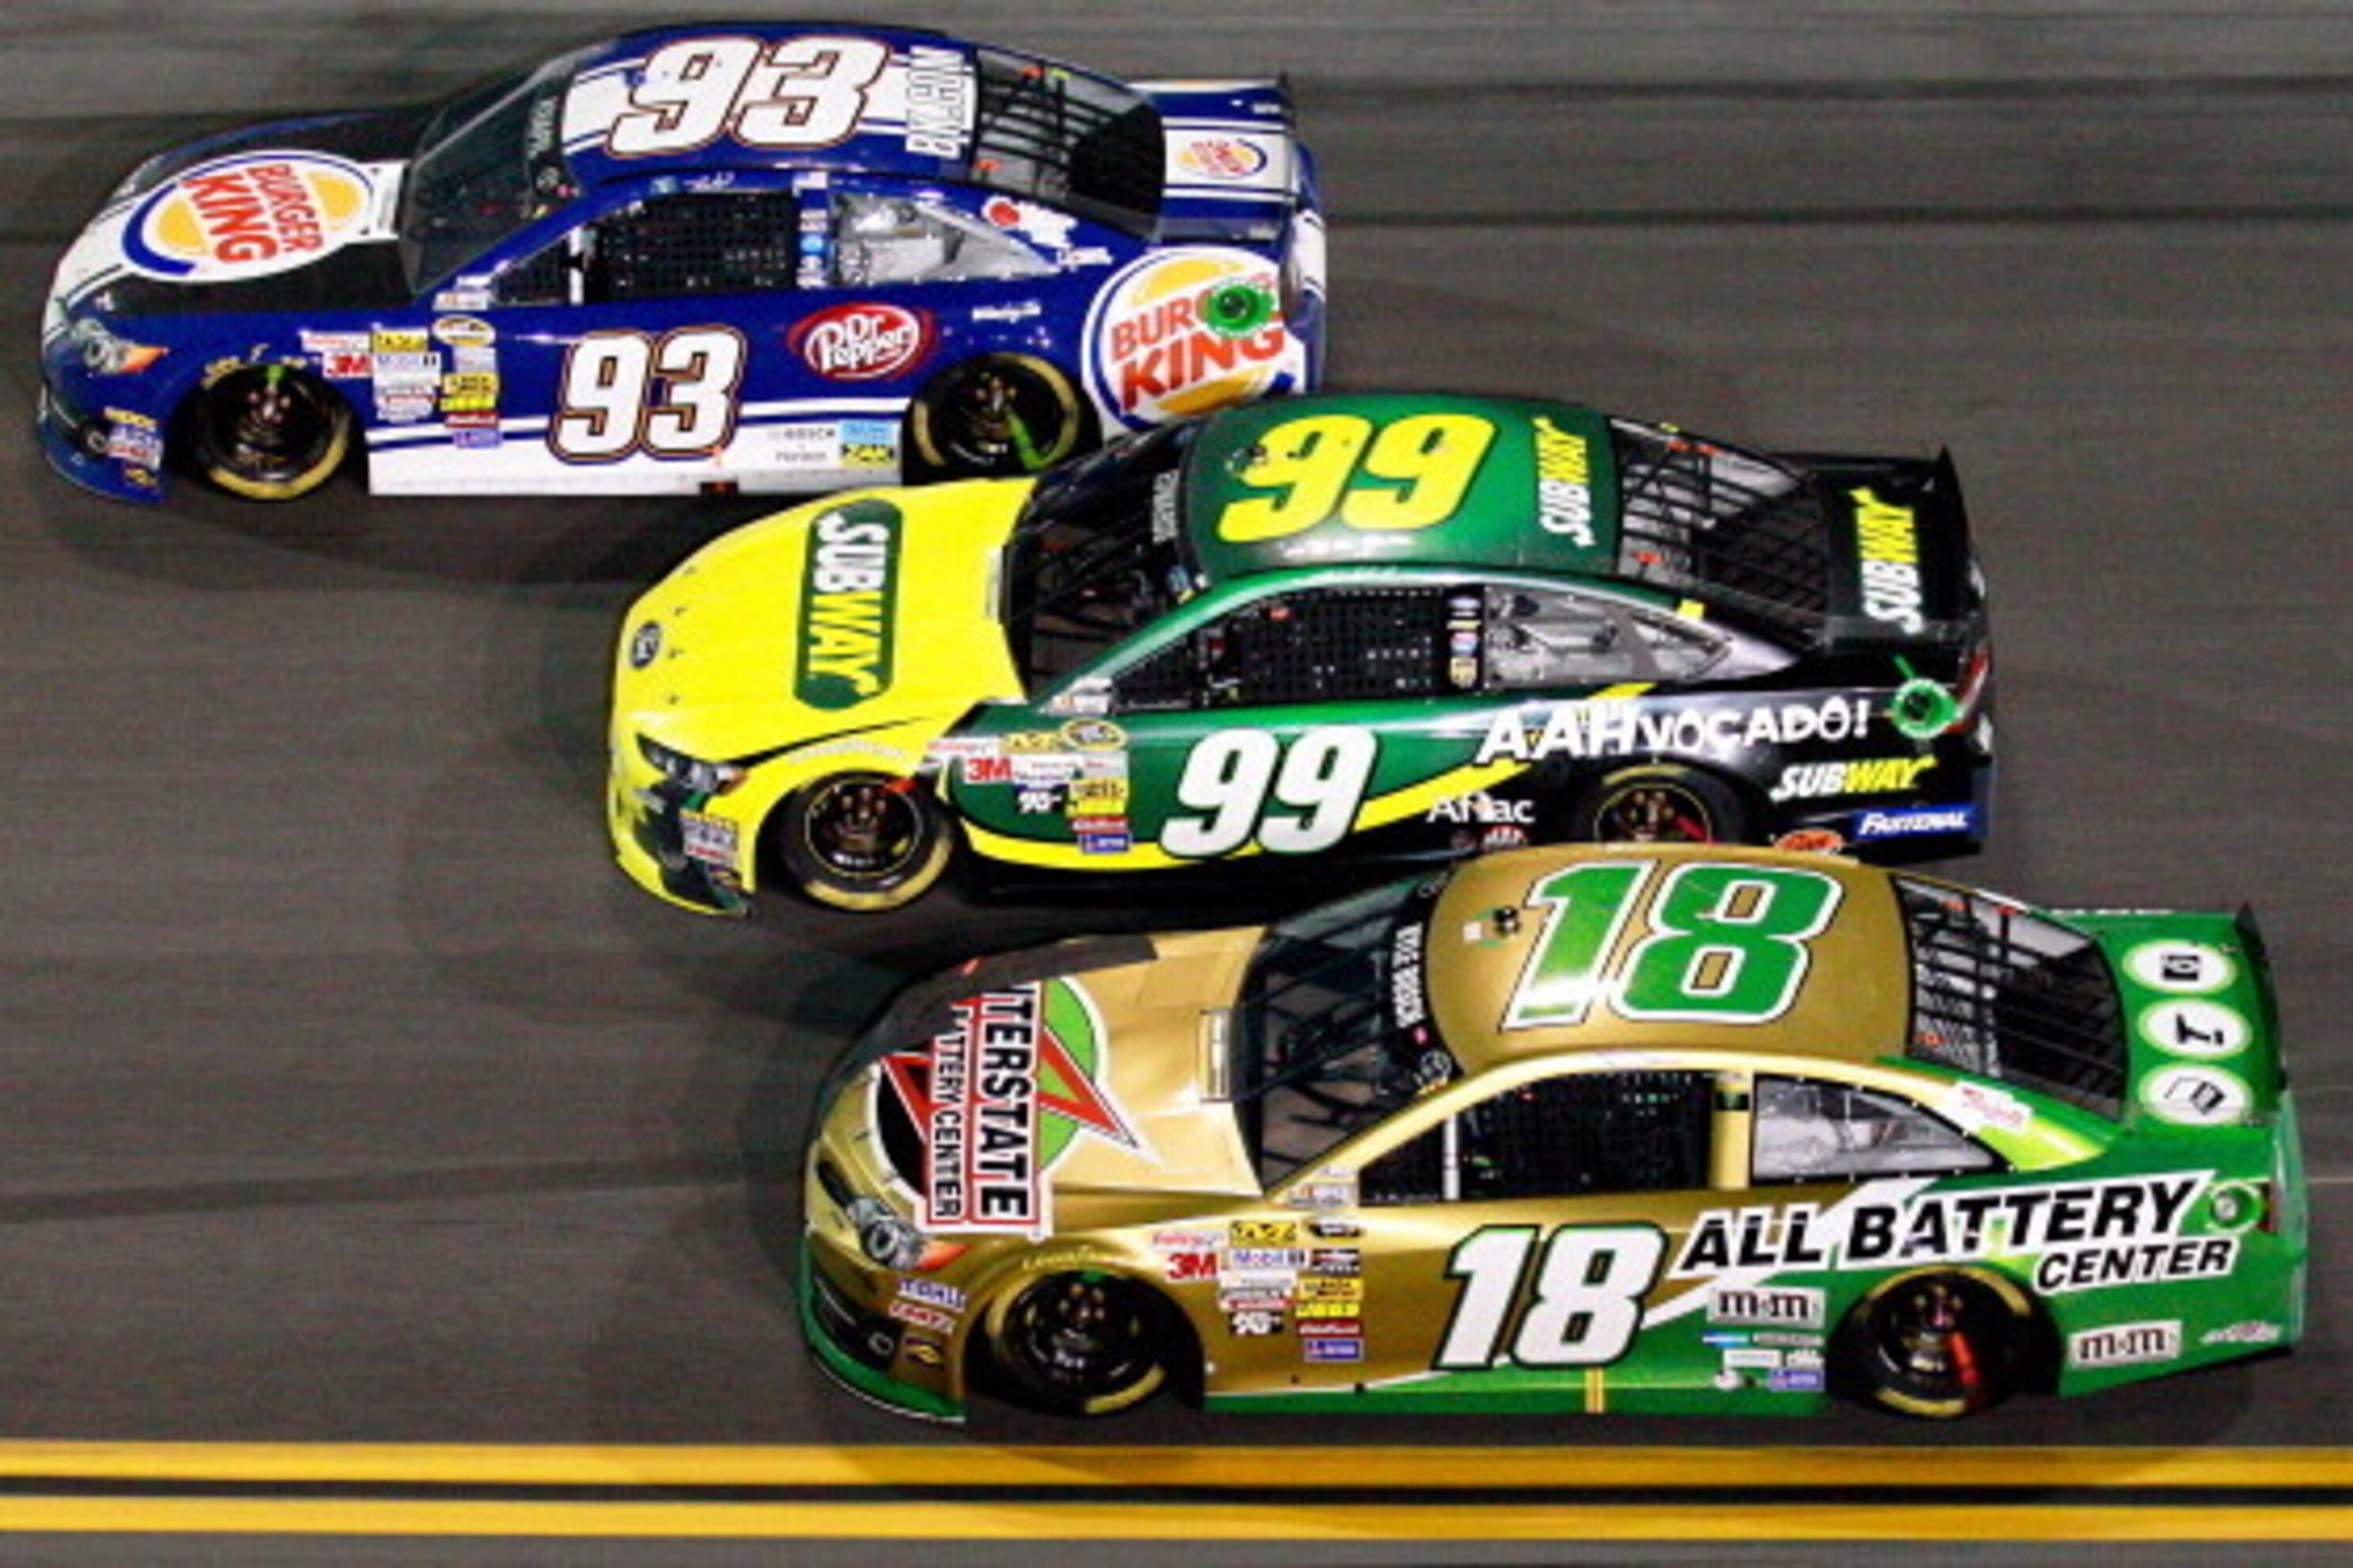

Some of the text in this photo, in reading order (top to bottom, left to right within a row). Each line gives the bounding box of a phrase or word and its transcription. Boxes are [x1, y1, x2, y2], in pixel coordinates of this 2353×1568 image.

[607, 35, 891, 158] 93
[182, 173, 278, 263] KING
[245, 162, 323, 253] BURGER
[804, 320, 914, 374] Pepper
[843, 313, 886, 342] Dr
[1110, 273, 1285, 364] BUR
[1120, 327, 1284, 411] KING
[545, 325, 747, 466] 93
[1218, 413, 1496, 542] 99
[1533, 416, 1598, 547] SUBWAY
[808, 512, 891, 696] SUBWAY
[1849, 485, 1926, 634] SUBWAY
[965, 757, 1012, 782] 3M
[1160, 723, 1378, 856] 99
[1768, 754, 1938, 803] SUBWAY
[1499, 859, 1846, 1033] 18
[981, 986, 1037, 1218] TERSTATE
[933, 1109, 963, 1218] CENTER
[1167, 1252, 1218, 1279] 3M
[1681, 1178, 2200, 1271] ALL BATTERY
[2037, 1238, 2233, 1290] CENTER
[1431, 1220, 1670, 1370] 18
